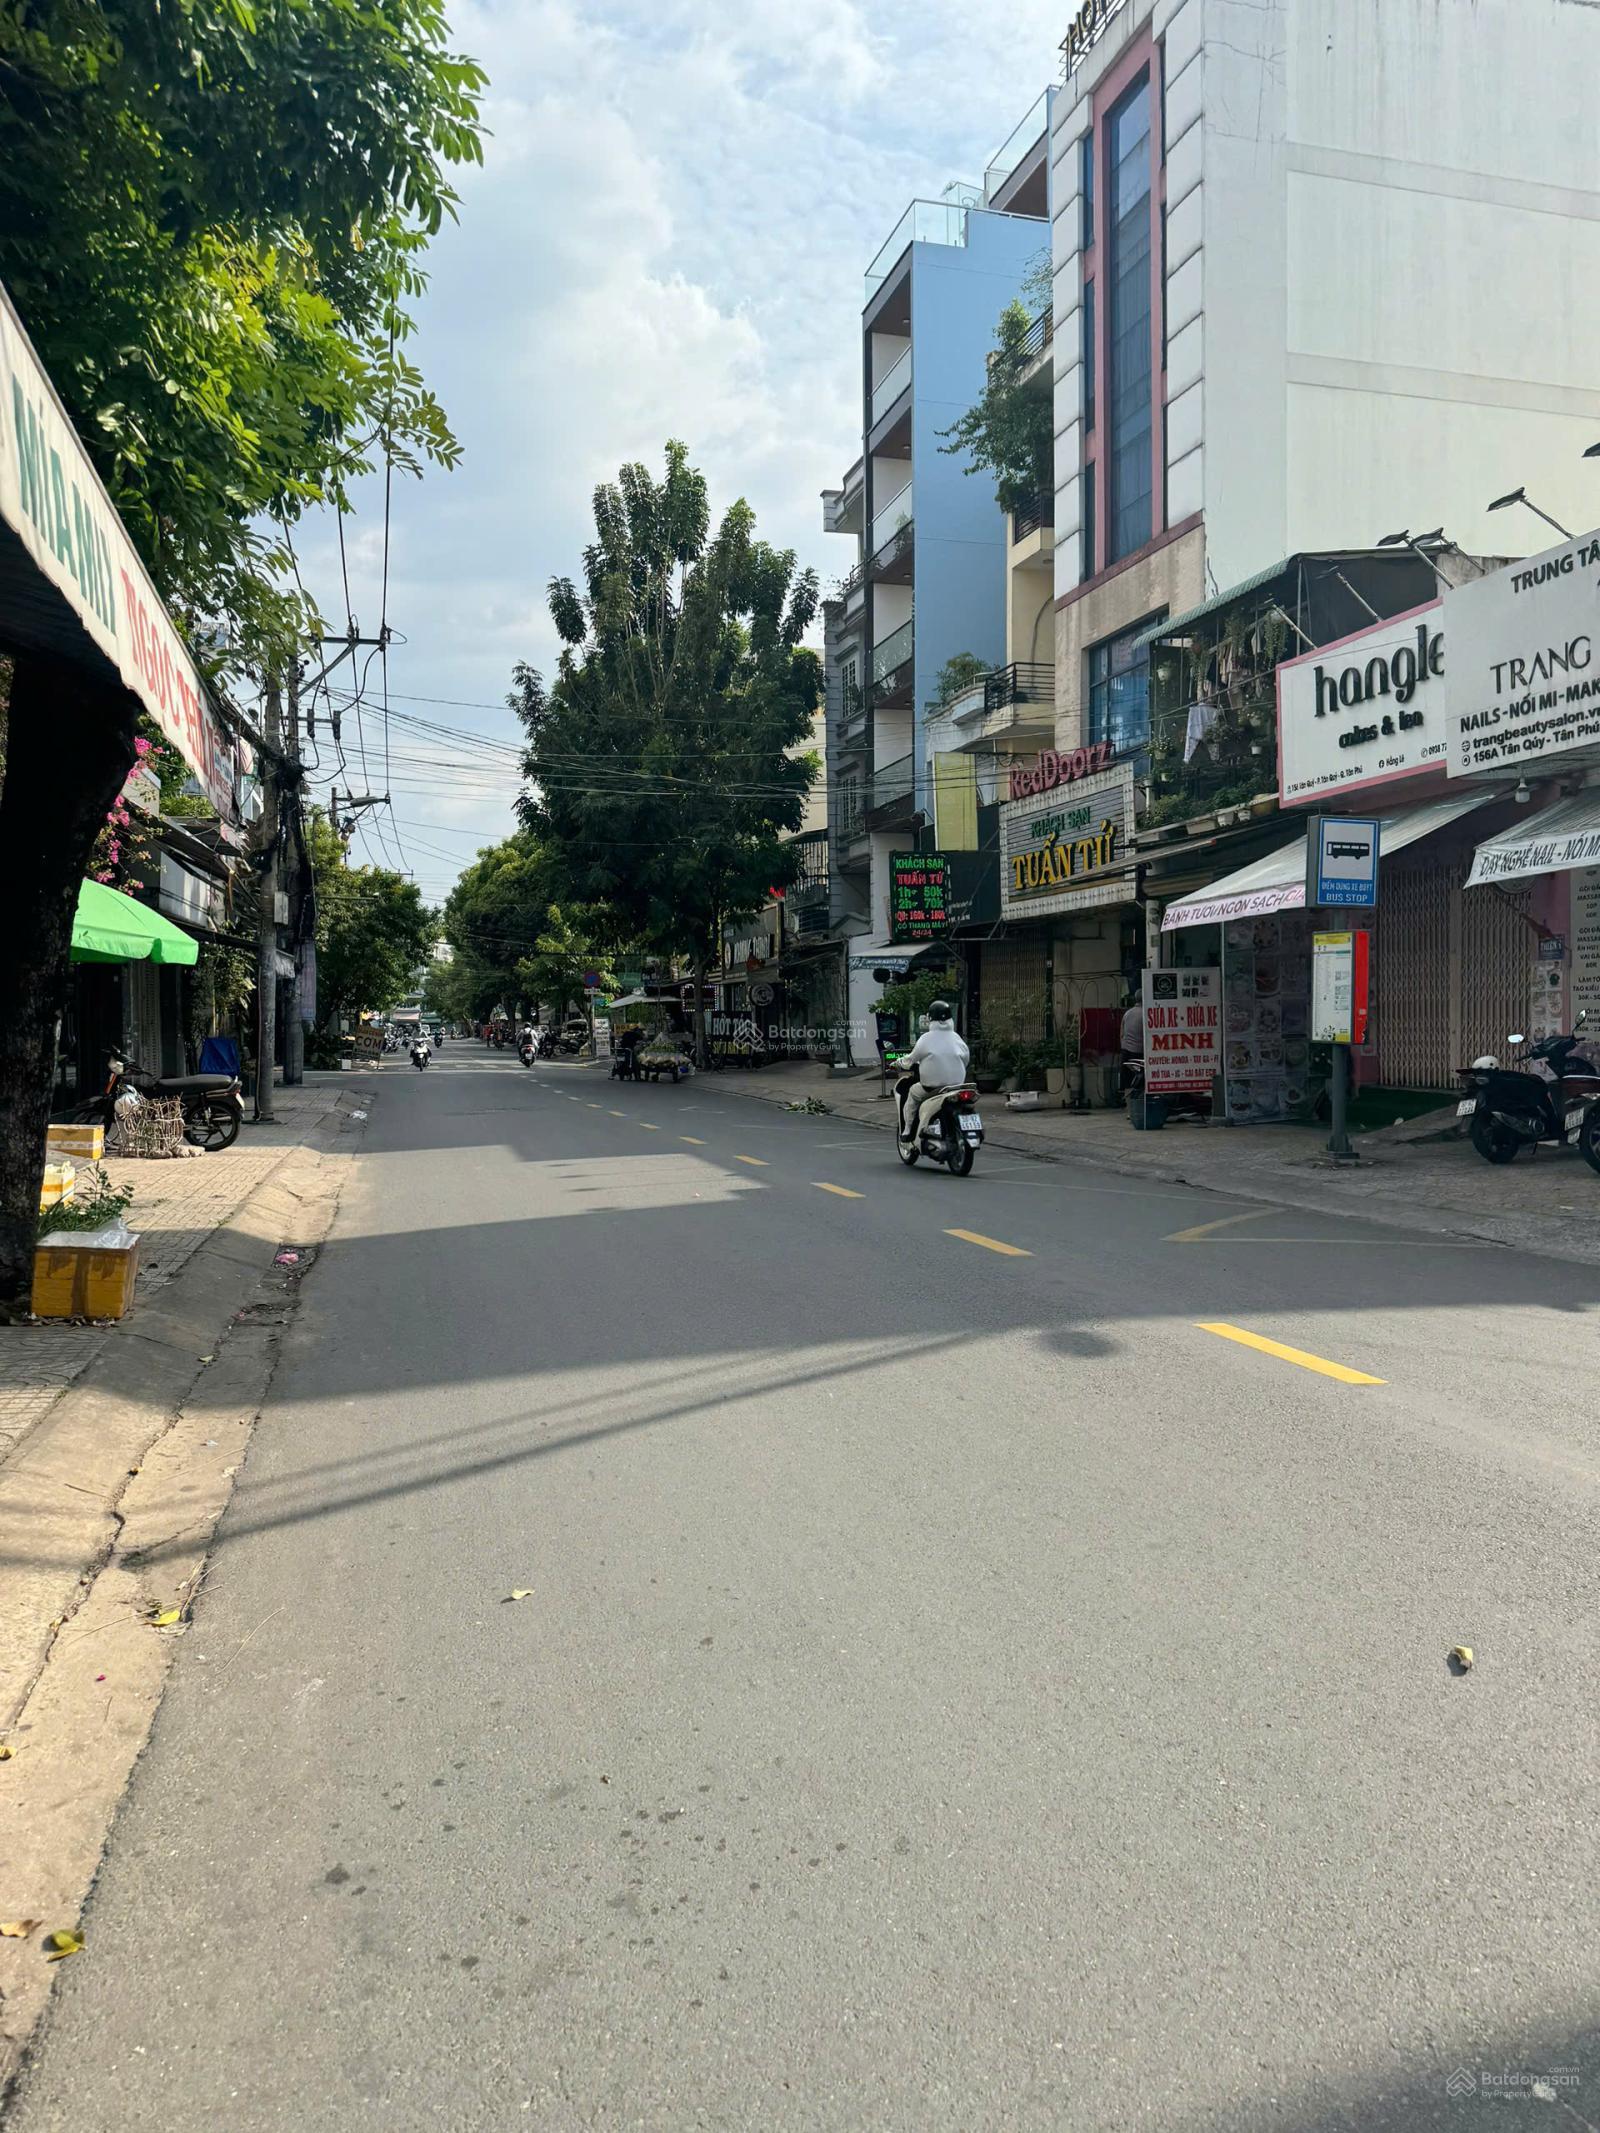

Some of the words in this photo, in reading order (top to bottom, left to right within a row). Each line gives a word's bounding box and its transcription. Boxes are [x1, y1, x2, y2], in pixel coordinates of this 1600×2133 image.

[1511, 554, 1574, 594] TRUNG
[1490, 635, 1591, 695] TRANG
[1381, 715, 1395, 736] &
[1473, 748, 1499, 763] 156A
[1500, 744, 1521, 758] Tân
[1553, 729, 1575, 743] Tân
[1009, 741, 1112, 799] RedDoorz
[1031, 812, 1065, 838] KHÁCH
[1067, 806, 1091, 830] SẠN
[895, 856, 925, 868] KHÁCH
[1012, 831, 1073, 890] TUẤN
[1326, 893, 1343, 902] BUS
[1345, 894, 1368, 903] STOP
[1147, 1001, 1166, 1029] SỬA
[1168, 1006, 1178, 1028] XE
[1187, 1000, 1205, 1027] RỬA
[1207, 1005, 1217, 1027] XE
[1152, 1032, 1214, 1051] MINH
